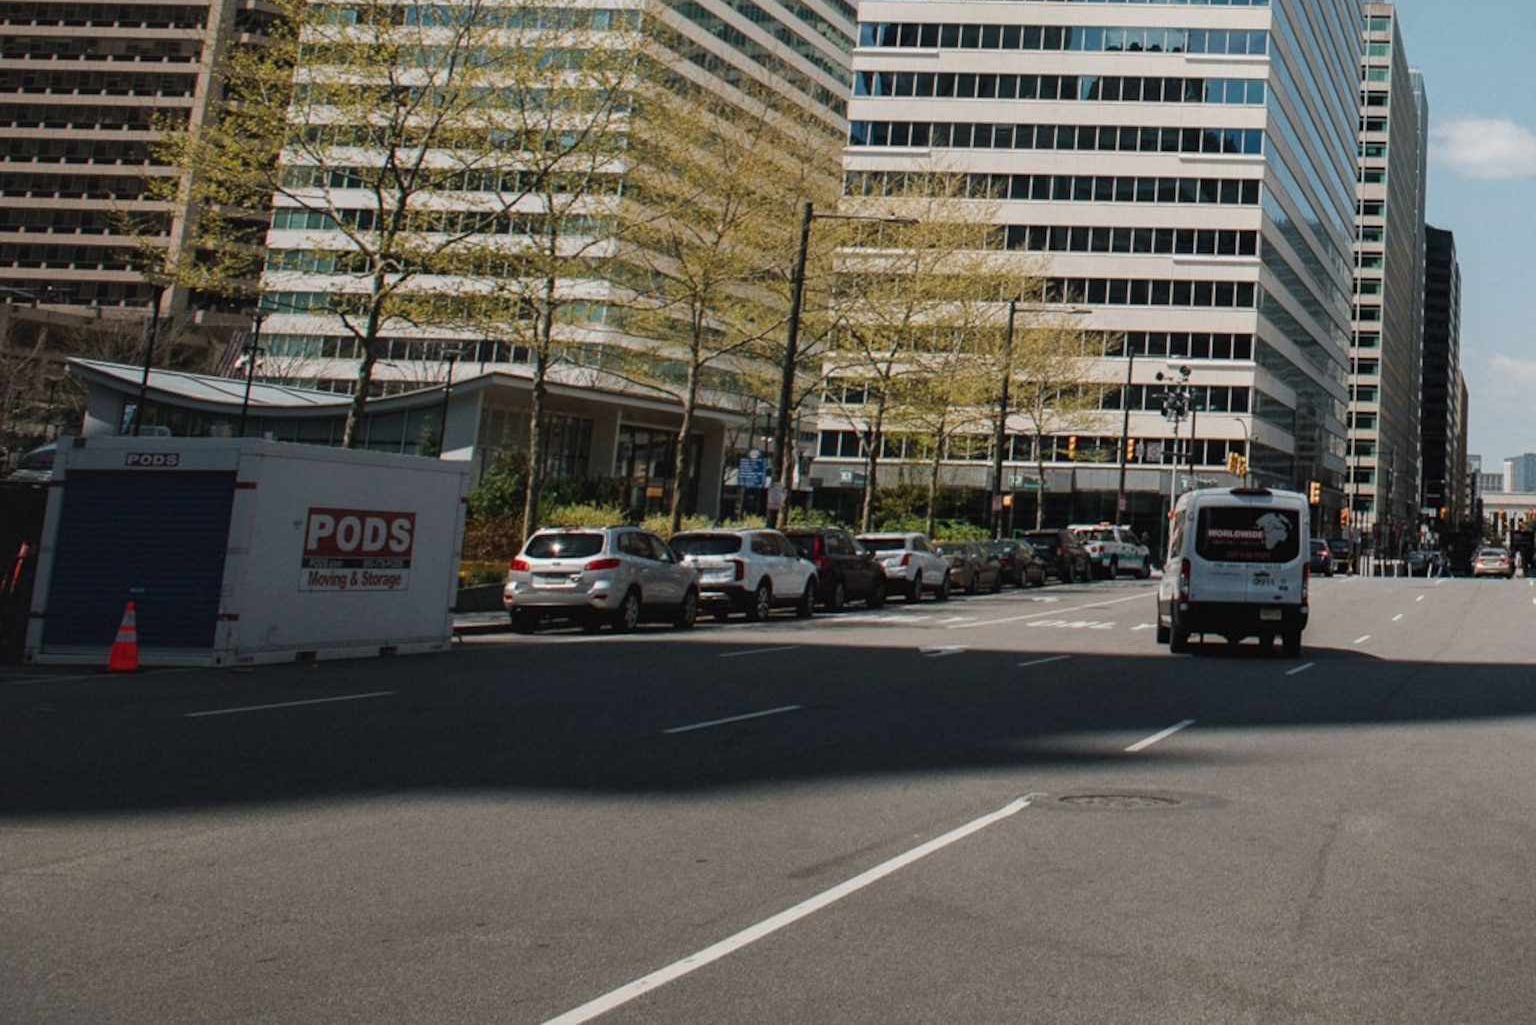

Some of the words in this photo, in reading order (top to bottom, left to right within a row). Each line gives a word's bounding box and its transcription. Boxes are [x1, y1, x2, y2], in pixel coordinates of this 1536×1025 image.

[126, 454, 178, 465] PODS
[307, 514, 412, 553] PODS
[1207, 529, 1264, 539] WORLDWIDE
[307, 571, 347, 589] Moving
[350, 571, 358, 586] &
[361, 571, 402, 588] Storage
